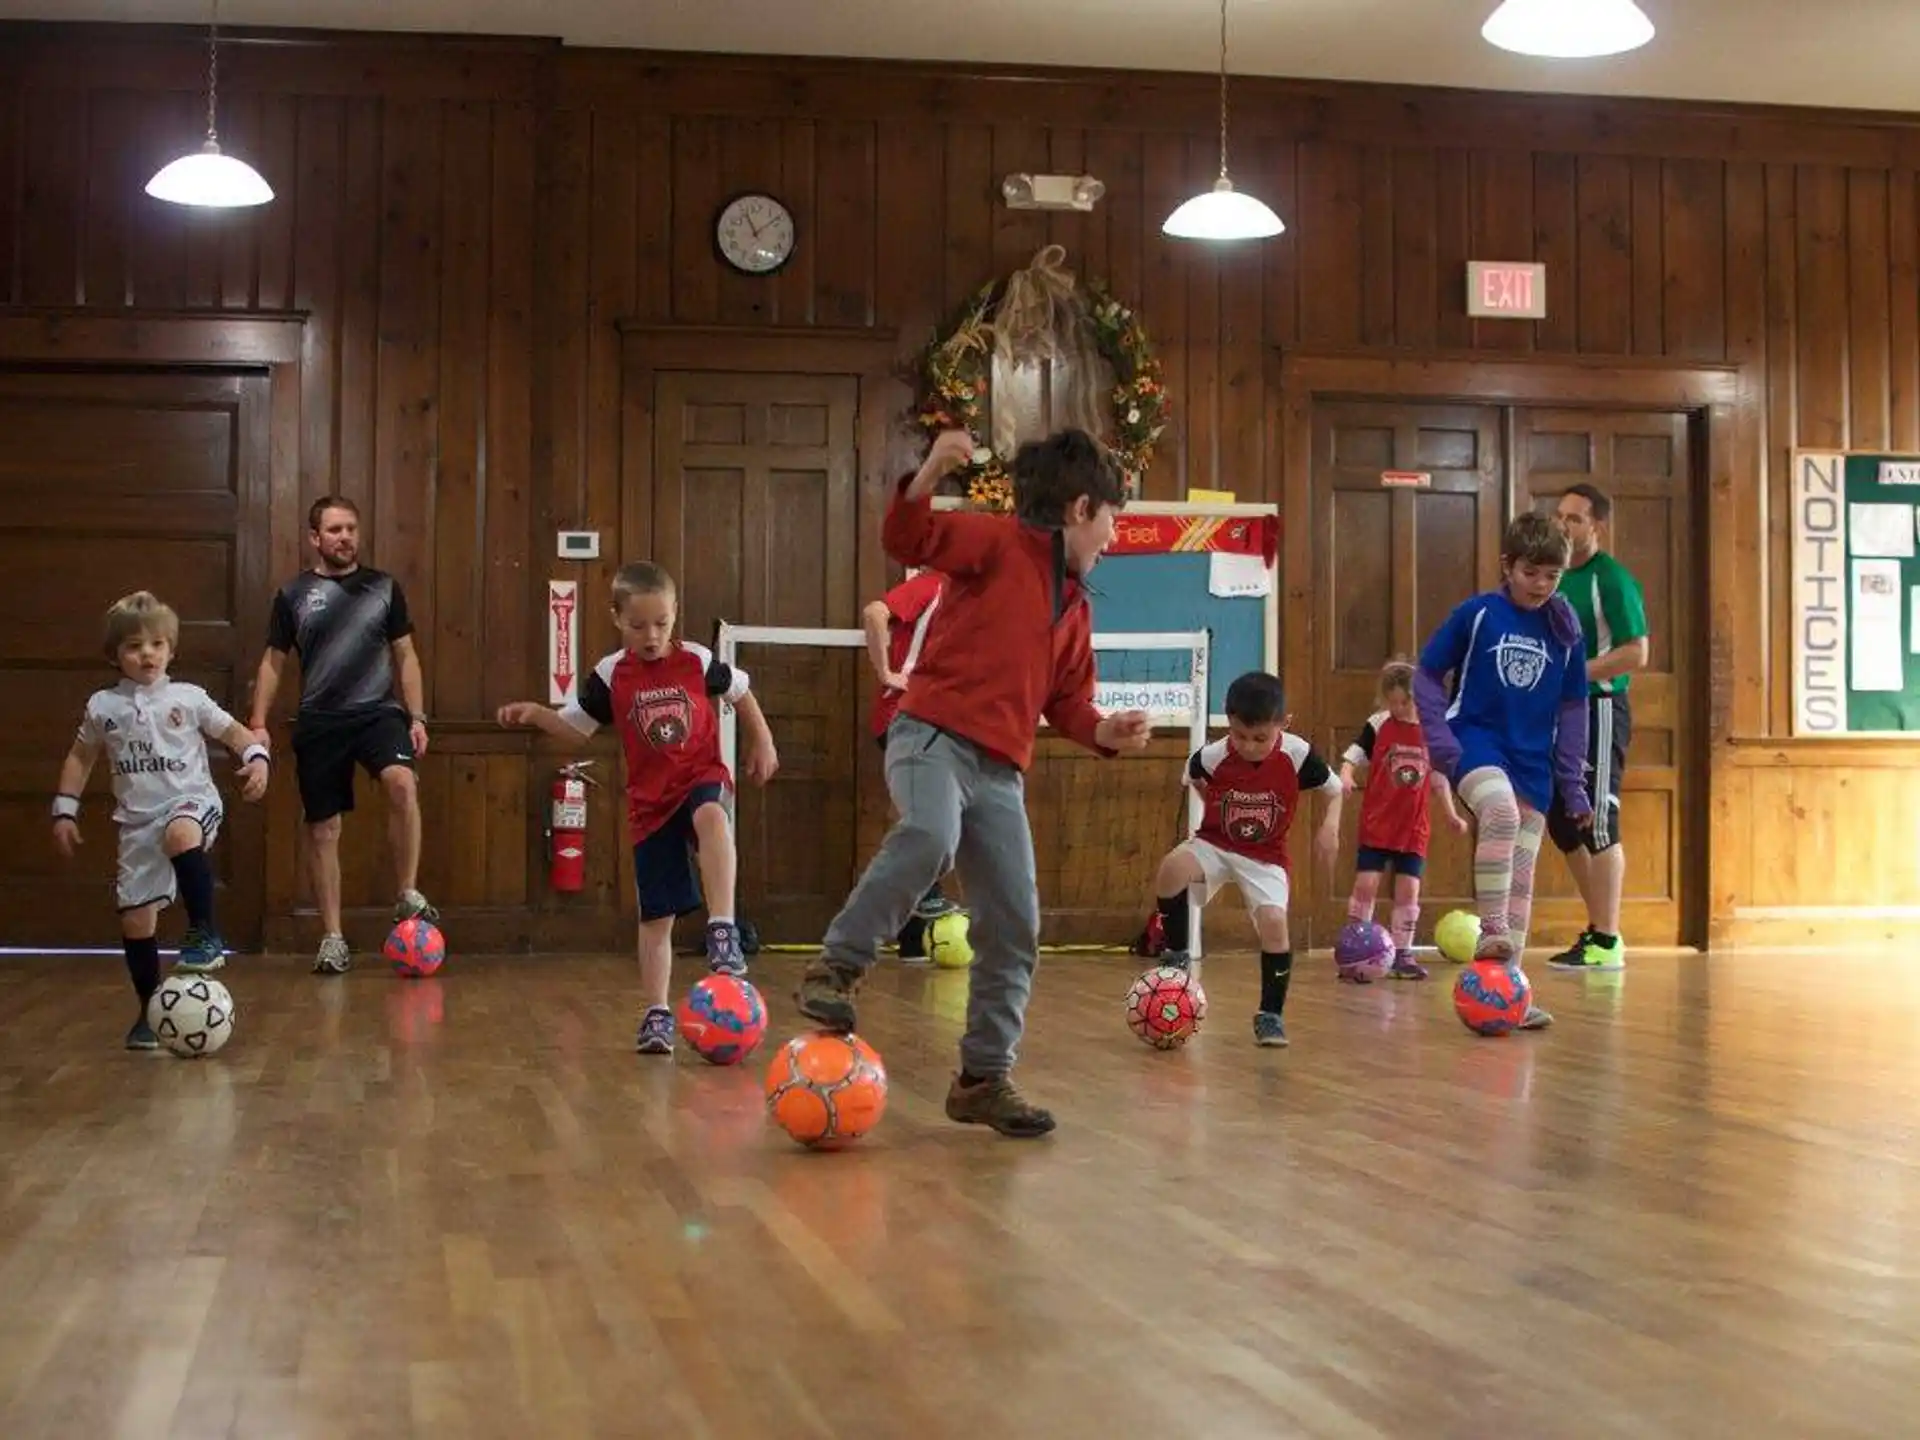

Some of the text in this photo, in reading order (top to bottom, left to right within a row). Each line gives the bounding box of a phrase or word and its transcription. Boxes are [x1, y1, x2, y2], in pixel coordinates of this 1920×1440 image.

[1484, 269, 1533, 309] EXIT
[1803, 457, 1838, 731] NOTICES
[128, 740, 154, 754] Fly
